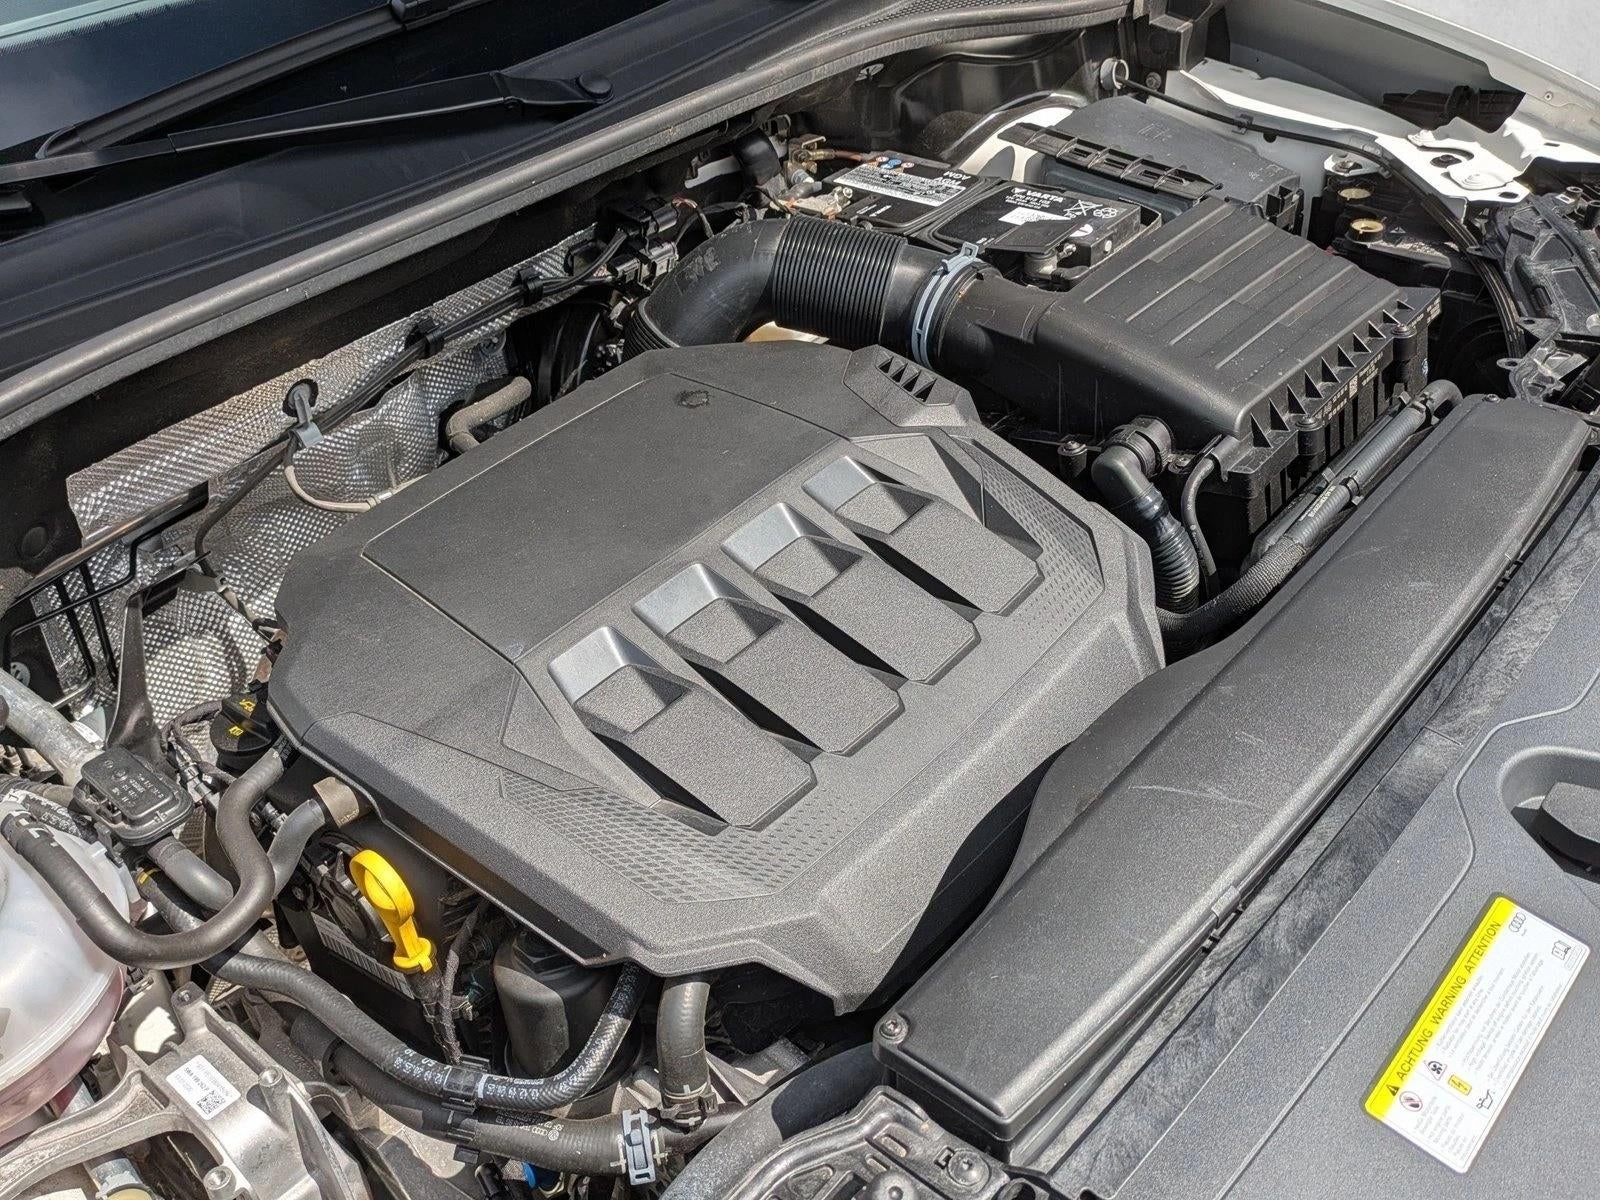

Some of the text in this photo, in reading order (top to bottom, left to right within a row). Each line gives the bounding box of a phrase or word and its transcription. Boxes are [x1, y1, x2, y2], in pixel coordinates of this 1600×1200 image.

[942, 170, 971, 180] AGM
[1026, 190, 1063, 202] VARTA
[1396, 1028, 1433, 1080] ACHTUNG
[1431, 976, 1467, 1024] WARNING
[1464, 920, 1501, 973] ATTENTION
